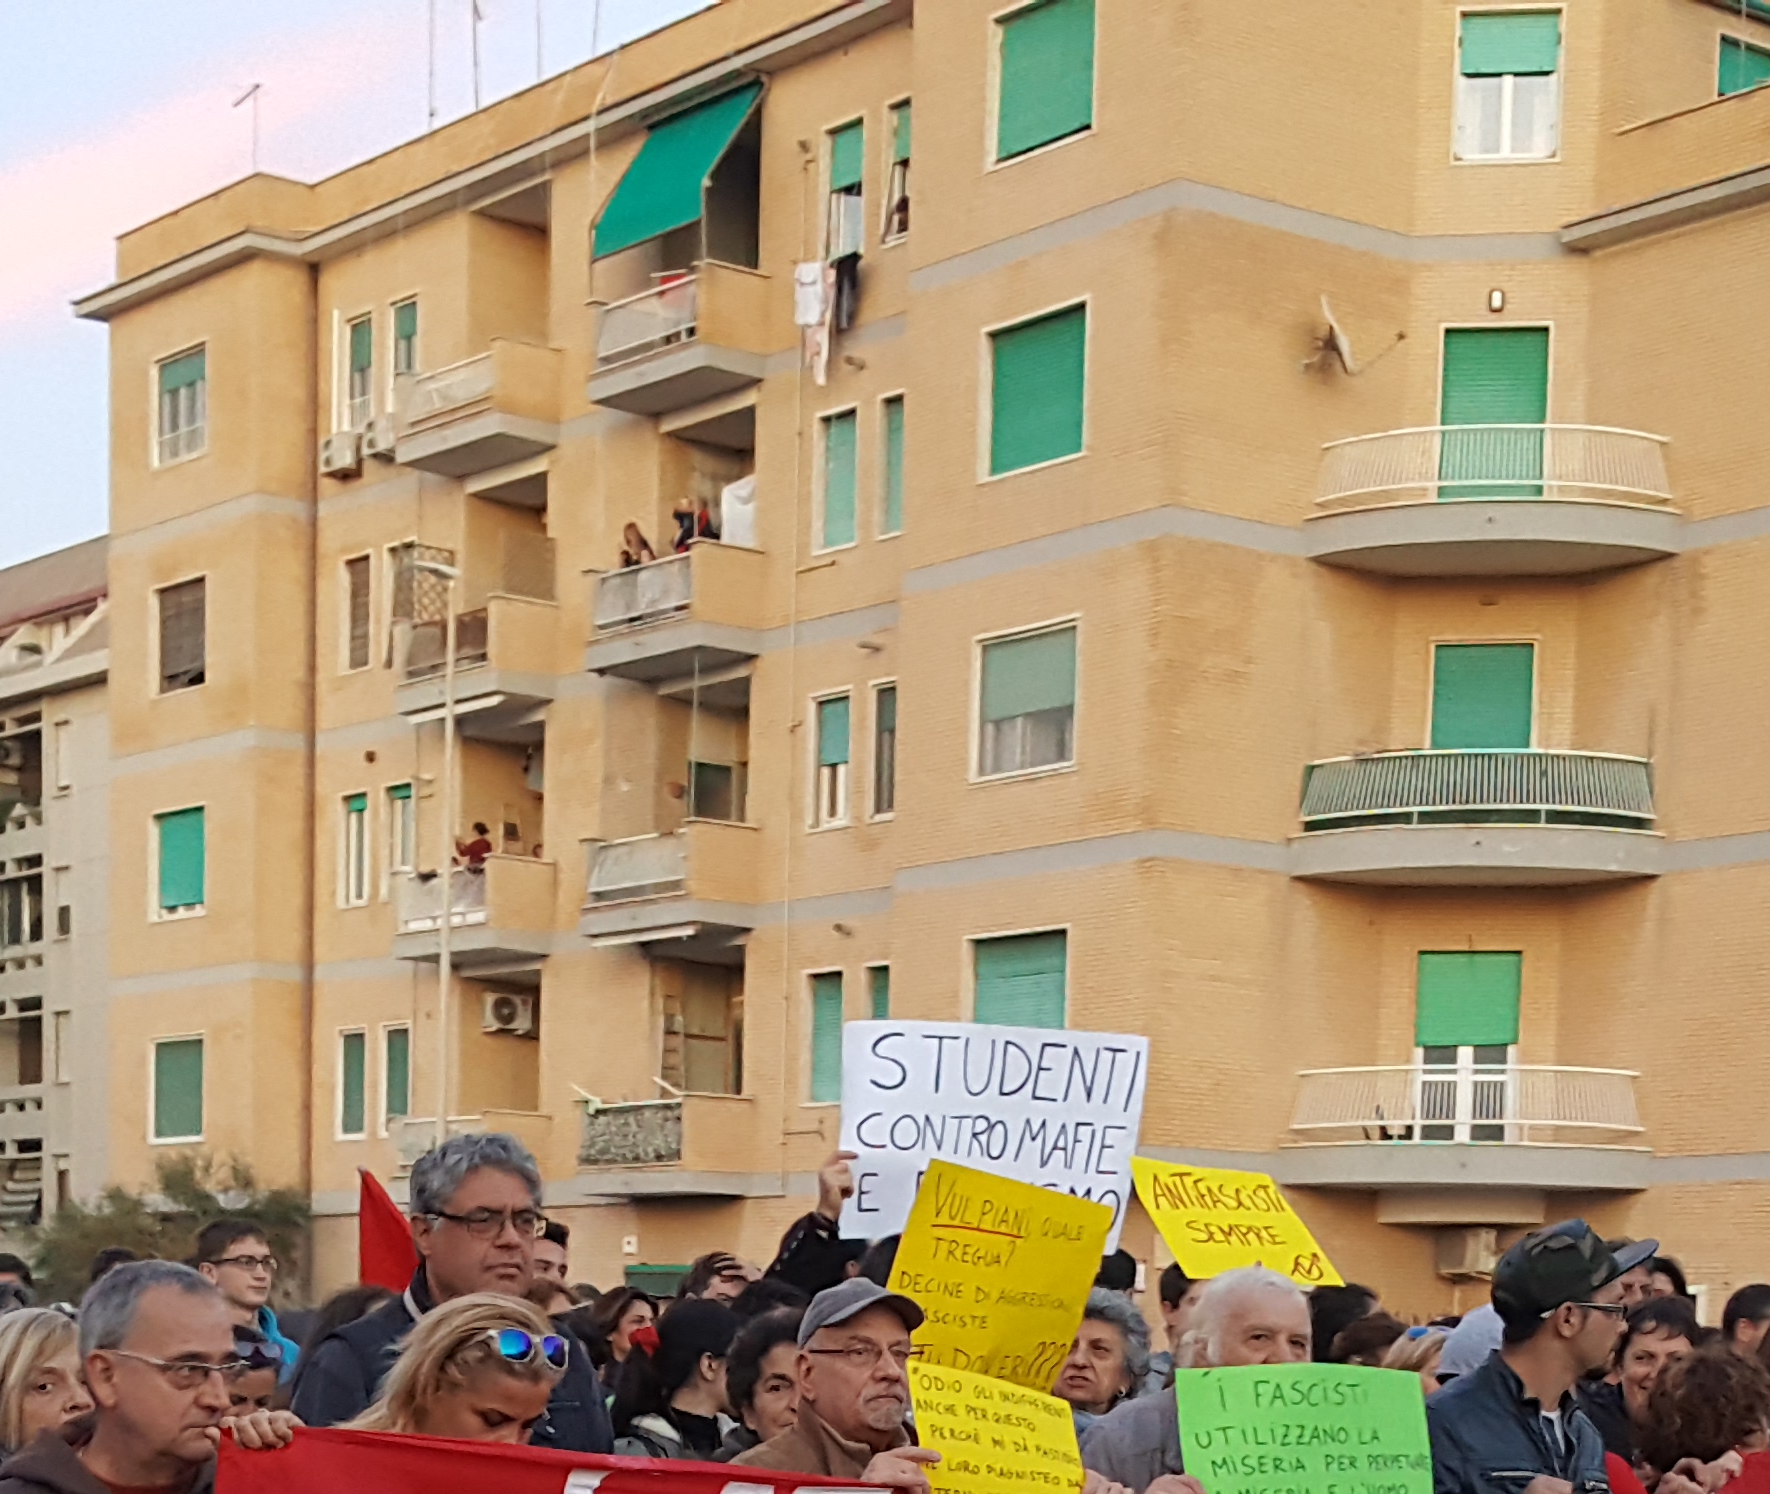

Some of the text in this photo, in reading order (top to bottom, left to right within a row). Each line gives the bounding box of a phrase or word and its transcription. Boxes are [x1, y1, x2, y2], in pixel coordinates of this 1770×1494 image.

[870, 1032, 1141, 1113] STUDENTI
[856, 1112, 1127, 1174] CONTRO MAFIE
[856, 1172, 880, 1213] E
[1185, 1219, 1287, 1246] SEMPRE
[932, 1237, 1017, 1268] TREGUA?
[898, 1270, 963, 1299] DECINE
[915, 1397, 958, 1418] ANCHE
[1357, 1427, 1381, 1446] LA
[947, 1459, 980, 1475] LORO
[1211, 1454, 1307, 1478] MISERIA
[1325, 1453, 1358, 1472] PER
